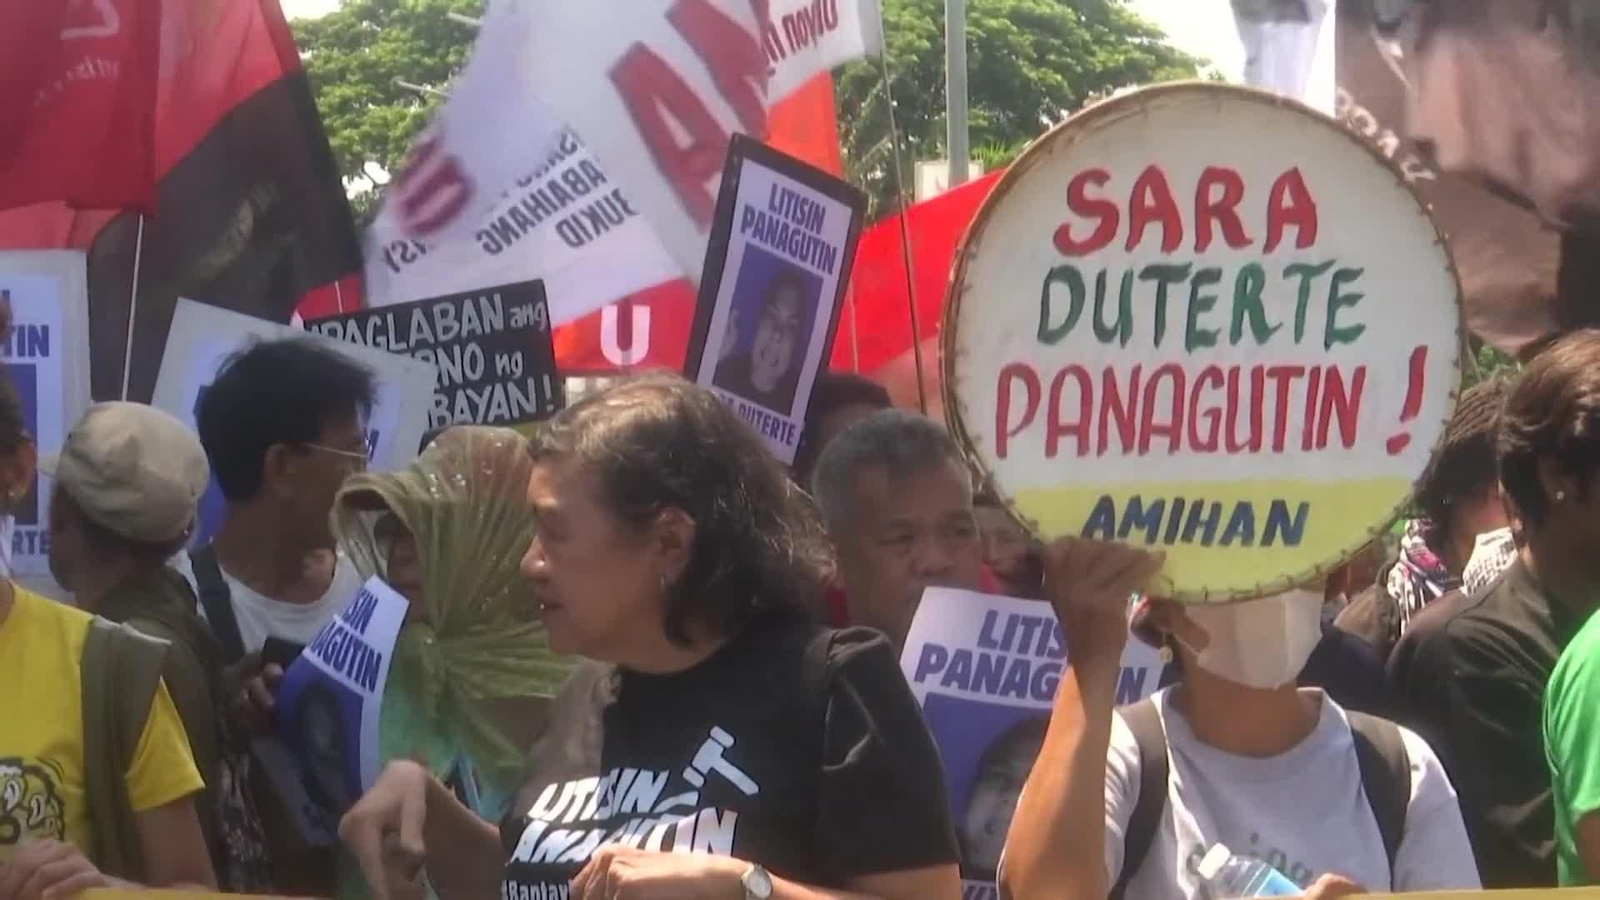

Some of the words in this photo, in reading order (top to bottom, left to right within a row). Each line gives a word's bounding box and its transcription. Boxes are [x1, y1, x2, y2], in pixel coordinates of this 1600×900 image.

[740, 204, 838, 276] PANAGUTIN
[768, 182, 826, 235] LITISIN
[1053, 164, 1319, 256] SARA
[509, 301, 548, 333] ang
[1036, 259, 1367, 353] DUTERTE
[494, 350, 524, 379] ng
[995, 362, 1367, 459] PANAGUTIN
[1081, 494, 1310, 548] AMIHAN
